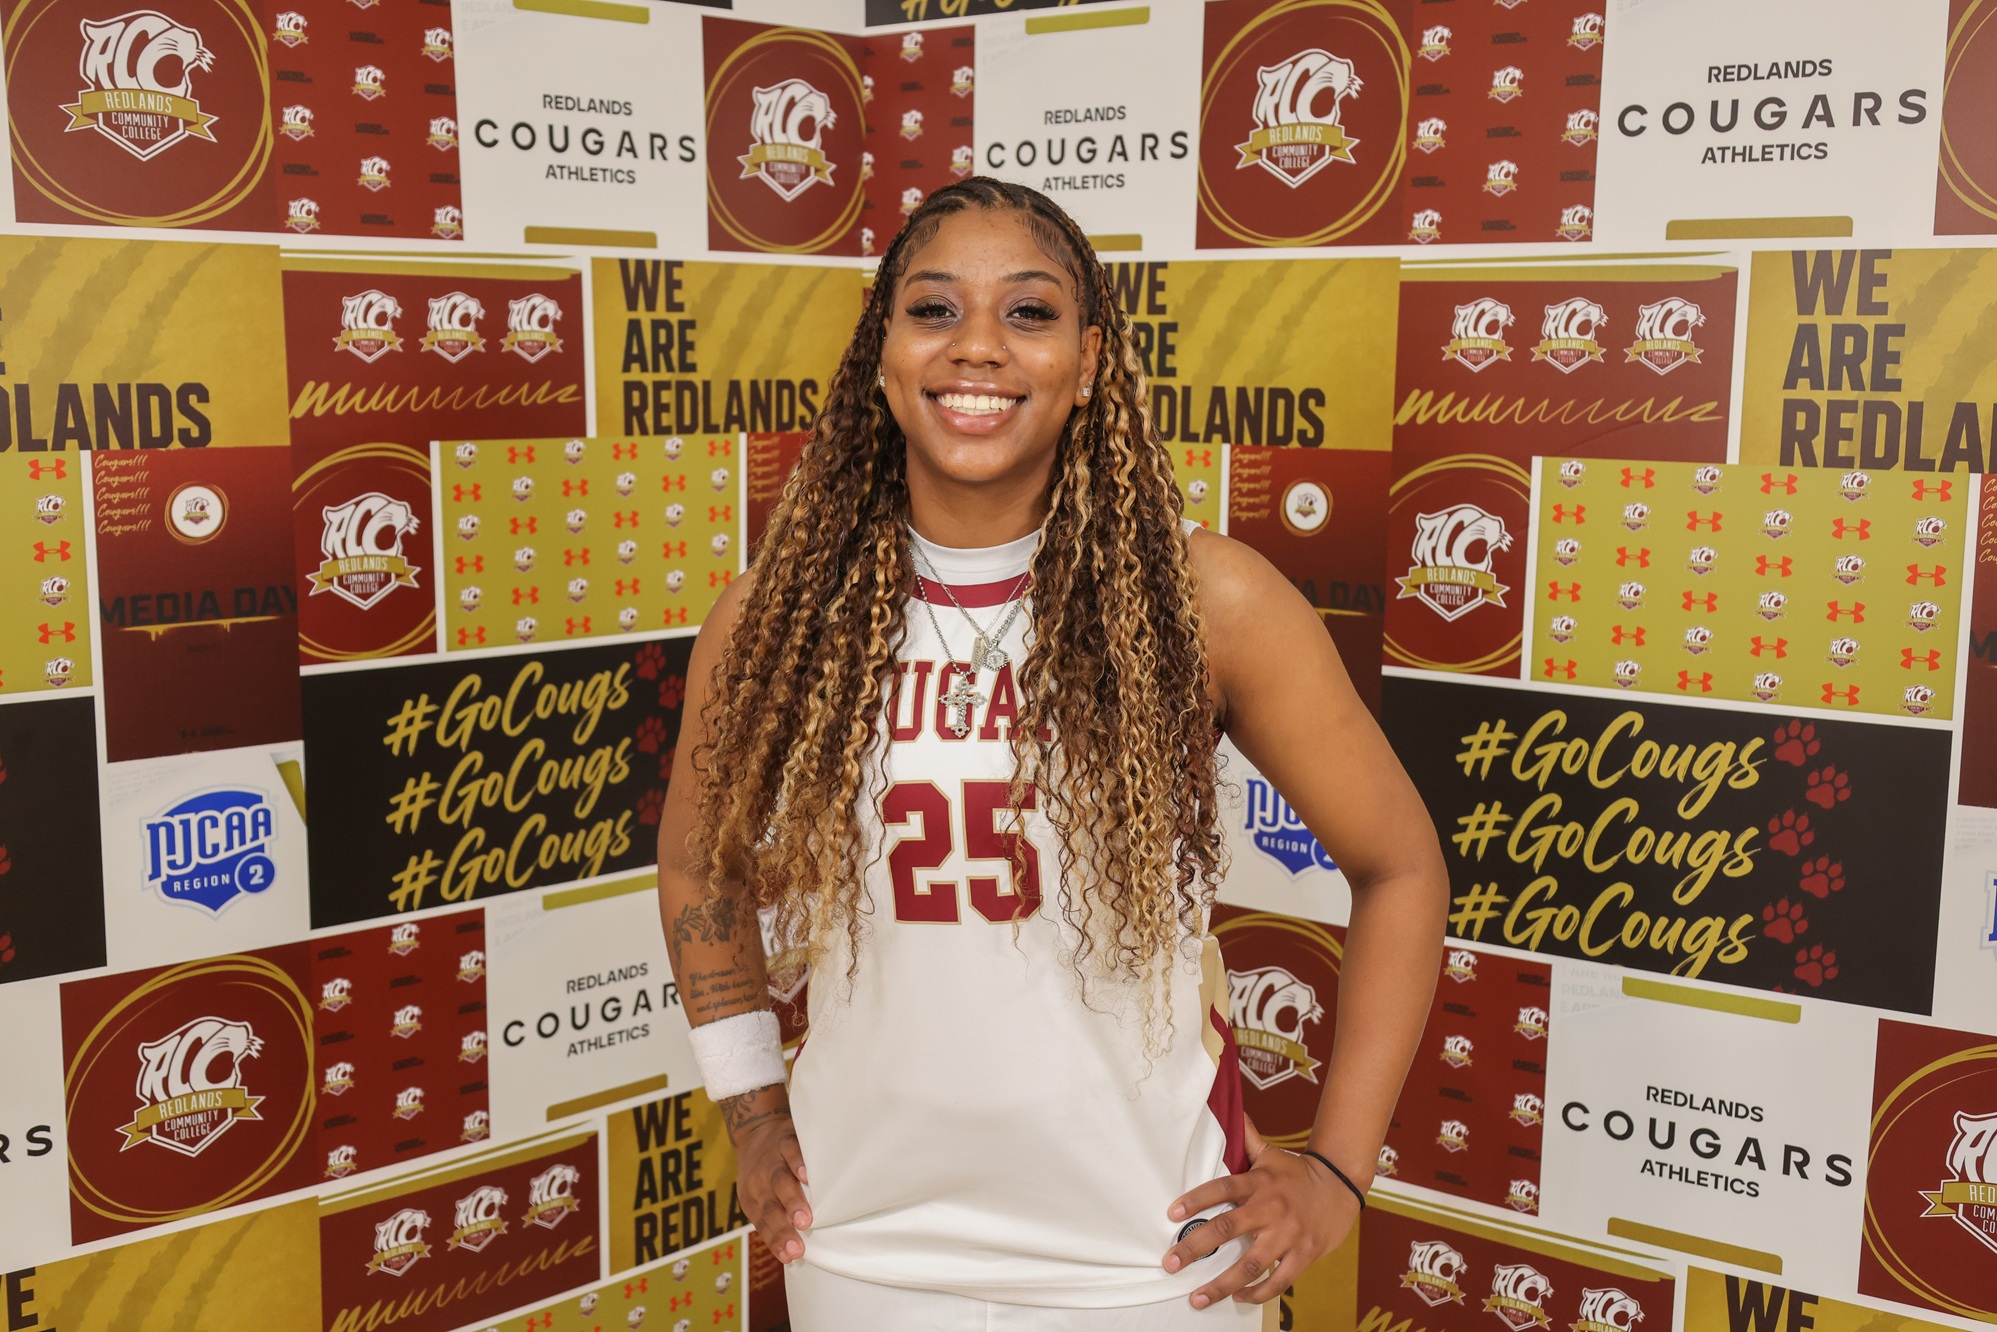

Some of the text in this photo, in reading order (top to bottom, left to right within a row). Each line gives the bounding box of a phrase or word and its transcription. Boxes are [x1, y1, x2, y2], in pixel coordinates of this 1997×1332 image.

[1707, 59, 1833, 83] REDLANDS
[105, 91, 173, 114] REDLANDS
[542, 94, 633, 116] REDLANDS
[1044, 105, 1127, 125] REDLANDS
[1617, 88, 1928, 137] COUGARS
[112, 112, 169, 128] COMMUNITY
[122, 125, 162, 141] COLLEGE
[474, 118, 697, 163] COUGARS
[1269, 125, 1324, 144] REDLANDS
[765, 145, 809, 162] REDLANDS
[986, 130, 1189, 169] COUGARS
[1272, 143, 1319, 158] COMMUNITY
[1279, 156, 1312, 169] COLLEGE
[1701, 142, 1828, 164] ATHLETICS
[545, 164, 636, 185] ATHLETICS
[1043, 174, 1126, 191] ATHLETICS
[618, 258, 685, 313] WE
[1791, 248, 1893, 316] WE
[351, 329, 383, 341] REDLANDS
[622, 318, 697, 374] ARE
[1461, 337, 1494, 349] REDLANDS
[1551, 337, 1585, 350] REDLANDS
[1645, 338, 1681, 350] REDLANDS
[1134, 321, 1178, 378] RE
[1648, 350, 1678, 358] COMMUNITY
[1782, 323, 1906, 392] ARE
[623, 378, 819, 437] REDLANDS
[1151, 385, 1326, 449] DLANDS
[1779, 397, 1997, 474] REDLA
[338, 557, 388, 574] REDLANDS
[343, 572, 385, 585] COMMUNITY
[1426, 568, 1477, 585] REDLANDS
[350, 582, 380, 594] COLLEGE
[1429, 583, 1472, 596] COMMUNITY
[1435, 593, 1466, 606] COLLEGE
[100, 584, 298, 627] MEDIA DAY
[383, 660, 634, 757] #GoCougs
[1455, 709, 1768, 820] #GoCougs
[385, 737, 634, 835] #GoCougs
[146, 807, 273, 882] NJCAA
[880, 778, 1044, 926] 25
[1262, 836, 1308, 854] REGION
[1452, 792, 1762, 906] #GoCougs
[388, 810, 634, 912] #GoCougs
[173, 864, 264, 892] REGION 2
[1448, 875, 1756, 979] #GoCougs
[566, 962, 649, 994] REDLANDS
[502, 981, 680, 1047] COUGAR
[566, 1023, 650, 1057] ATHLETICS
[1237, 1028, 1289, 1055] REDLANDS
[1240, 1045, 1285, 1066] COMMUNITY
[1246, 1058, 1277, 1075] COLLEGE
[159, 1091, 223, 1119] REDLANDS
[1645, 1085, 1764, 1123] REDLANDS
[164, 1109, 219, 1133] COMMUNITY
[174, 1122, 212, 1141] COLLEGE
[633, 1090, 693, 1154] WE
[1562, 1101, 1853, 1187] COUGARS
[633, 1140, 703, 1211] ARE
[1640, 1159, 1760, 1198] ATHLETICS
[635, 1181, 748, 1266] REDLA
[1417, 1272, 1447, 1289] REDLANDS
[1501, 1297, 1532, 1313] REDLANDS
